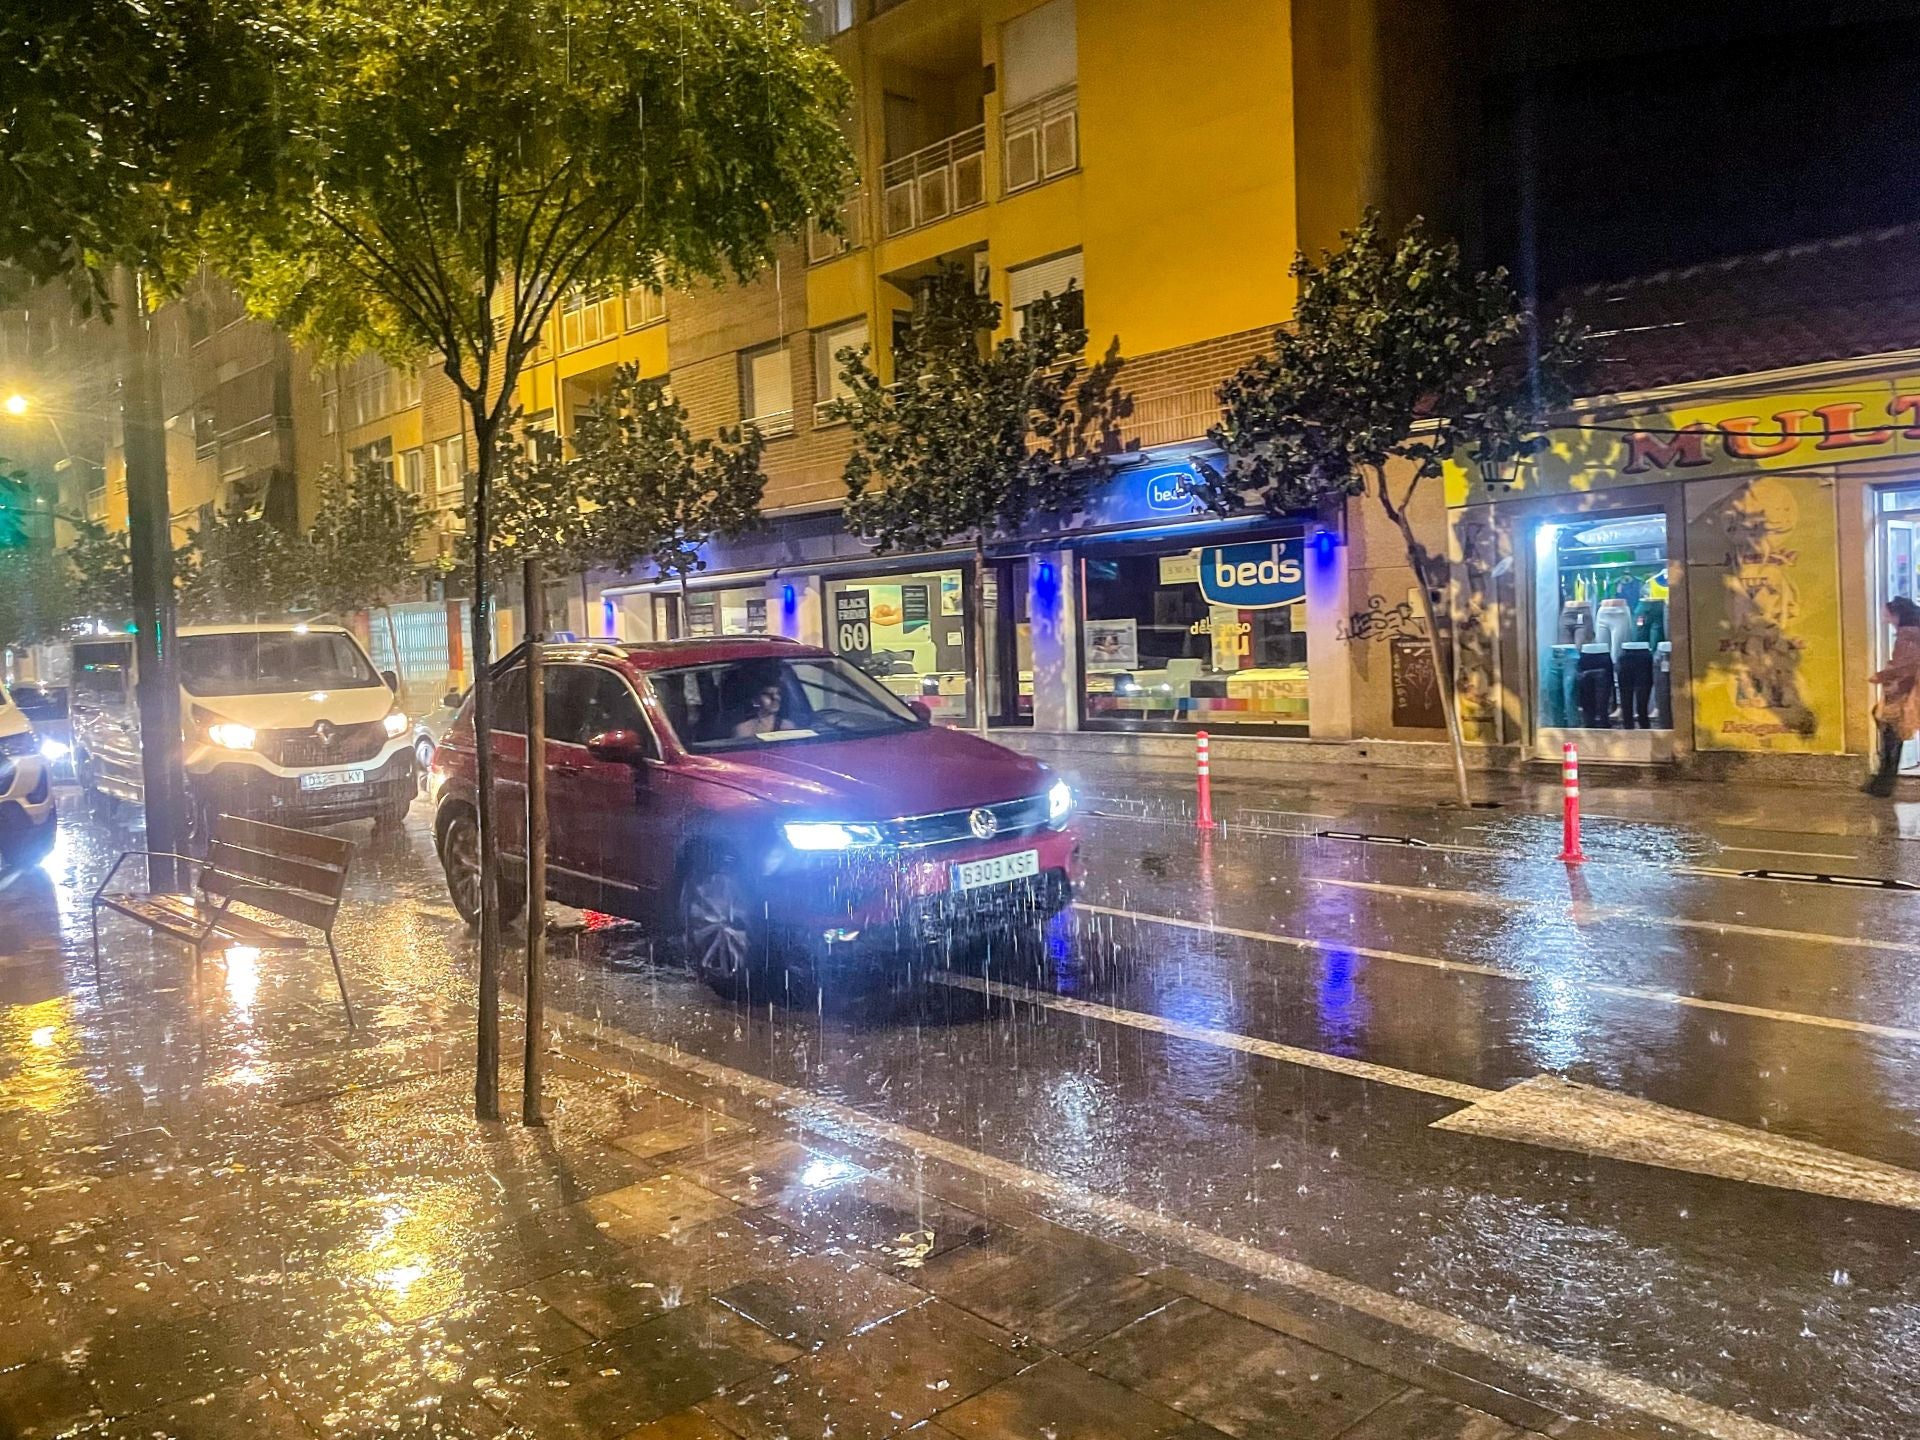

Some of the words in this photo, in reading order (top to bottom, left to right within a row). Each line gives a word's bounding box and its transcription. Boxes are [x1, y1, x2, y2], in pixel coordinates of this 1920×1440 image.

[1215, 543, 1302, 588] bed's
[840, 622, 870, 652] 60
[1190, 622, 1252, 635] desanso
[963, 861, 1001, 885] 6303
[1006, 853, 1034, 876] KSF
